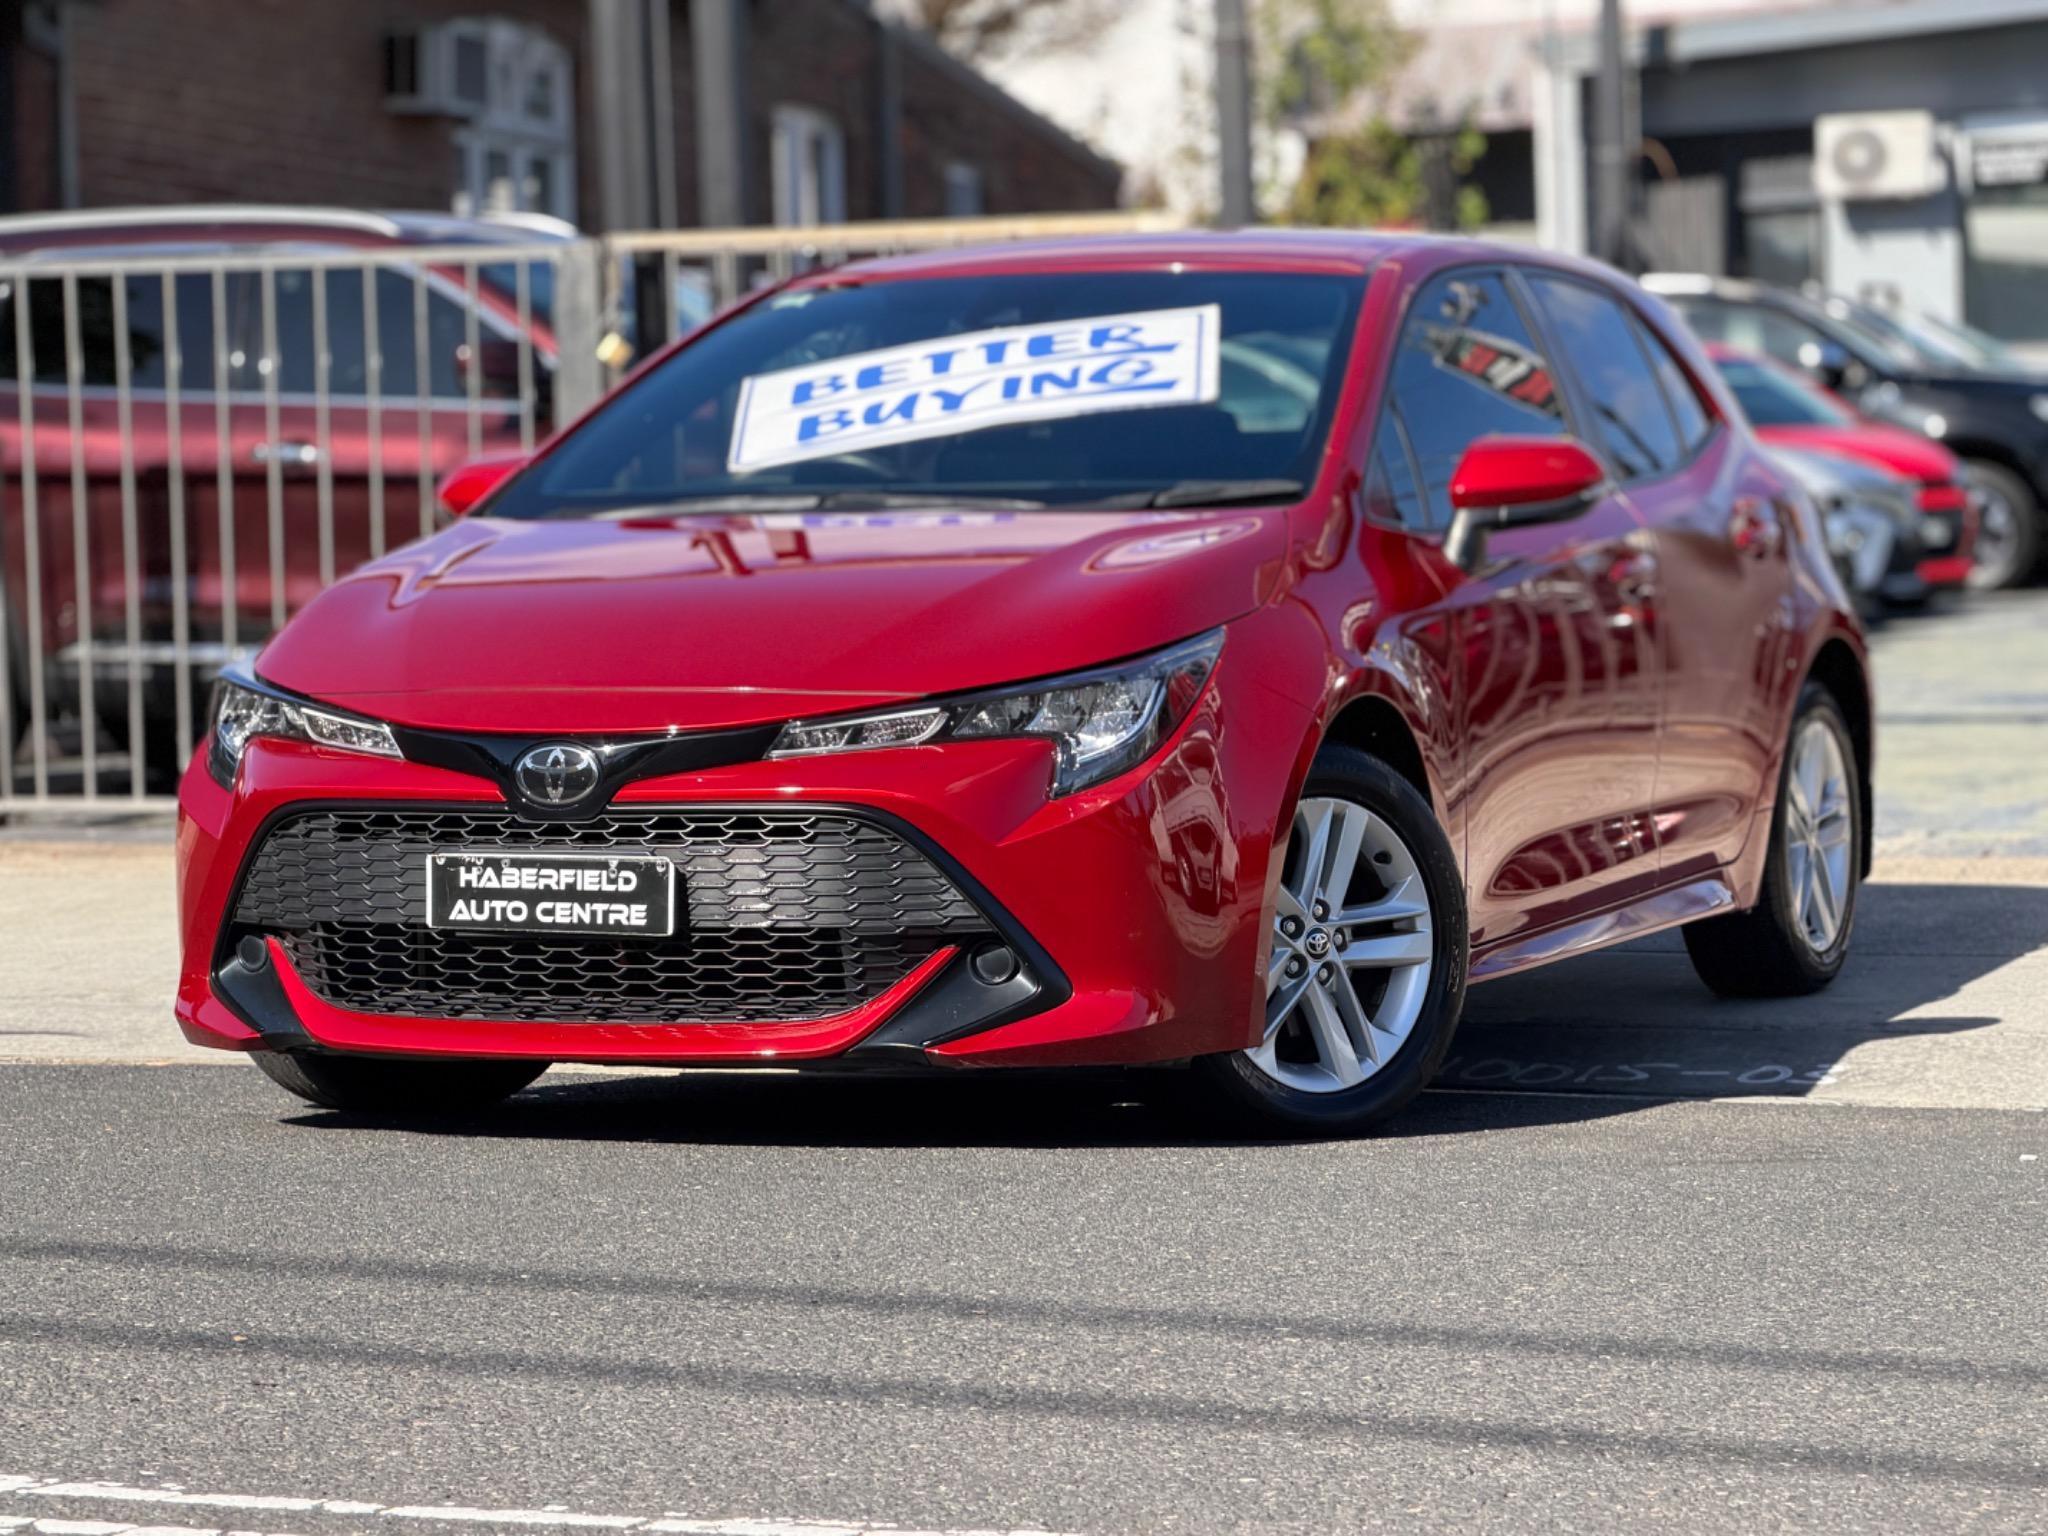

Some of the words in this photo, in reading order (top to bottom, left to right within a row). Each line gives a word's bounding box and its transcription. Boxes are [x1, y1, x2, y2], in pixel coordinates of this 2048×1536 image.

[792, 323, 1179, 406] BETTER
[797, 358, 1180, 443] BUYING
[459, 865, 638, 892] HABERFIELD
[449, 899, 528, 923] AUTO
[535, 902, 648, 926] CENTRE
